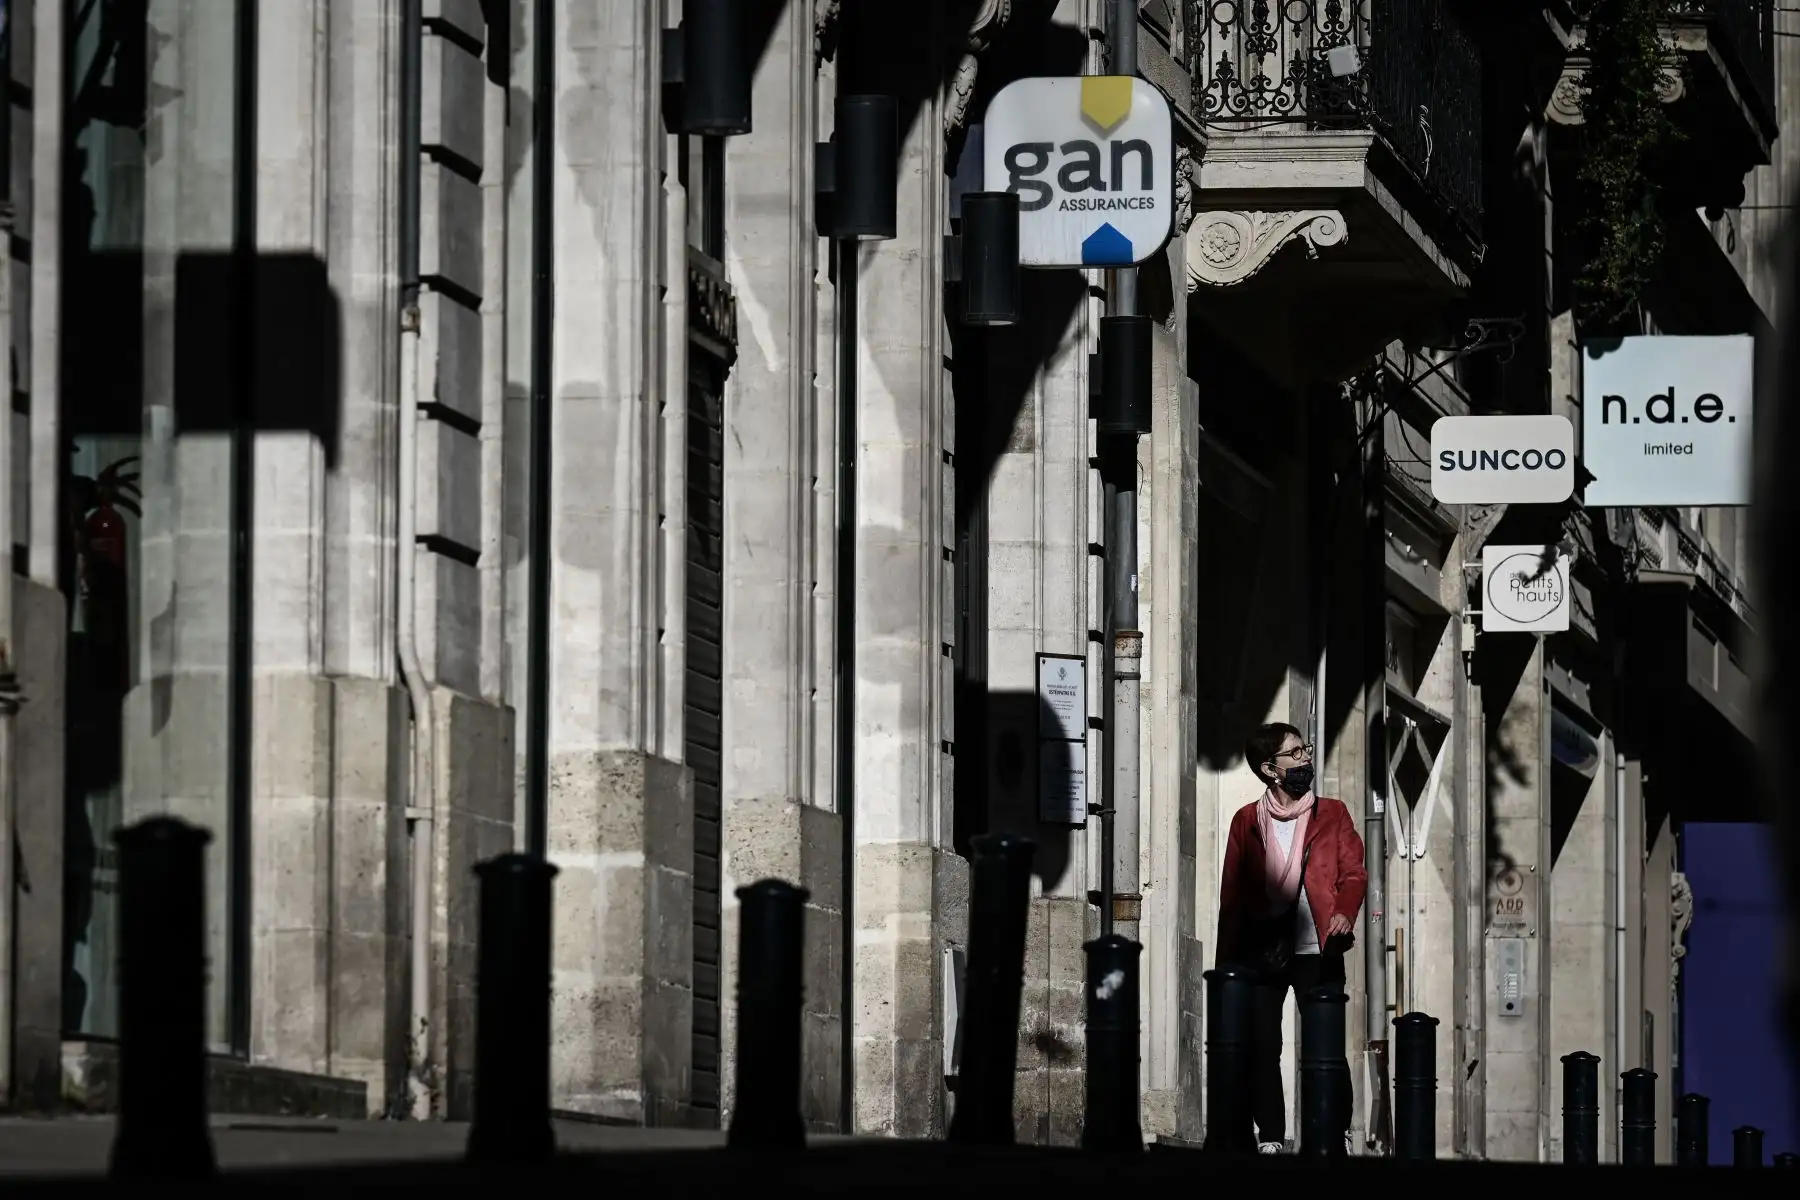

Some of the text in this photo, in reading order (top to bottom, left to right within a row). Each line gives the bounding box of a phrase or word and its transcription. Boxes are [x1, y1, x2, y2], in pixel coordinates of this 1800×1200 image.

[1004, 138, 1154, 212] gan
[1058, 196, 1155, 212] ASSURANCES
[1601, 386, 1736, 425] n.d.e.
[1644, 442, 1694, 456] limited
[1439, 448, 1567, 472] SUNCOO
[1517, 588, 1559, 602] hauts
